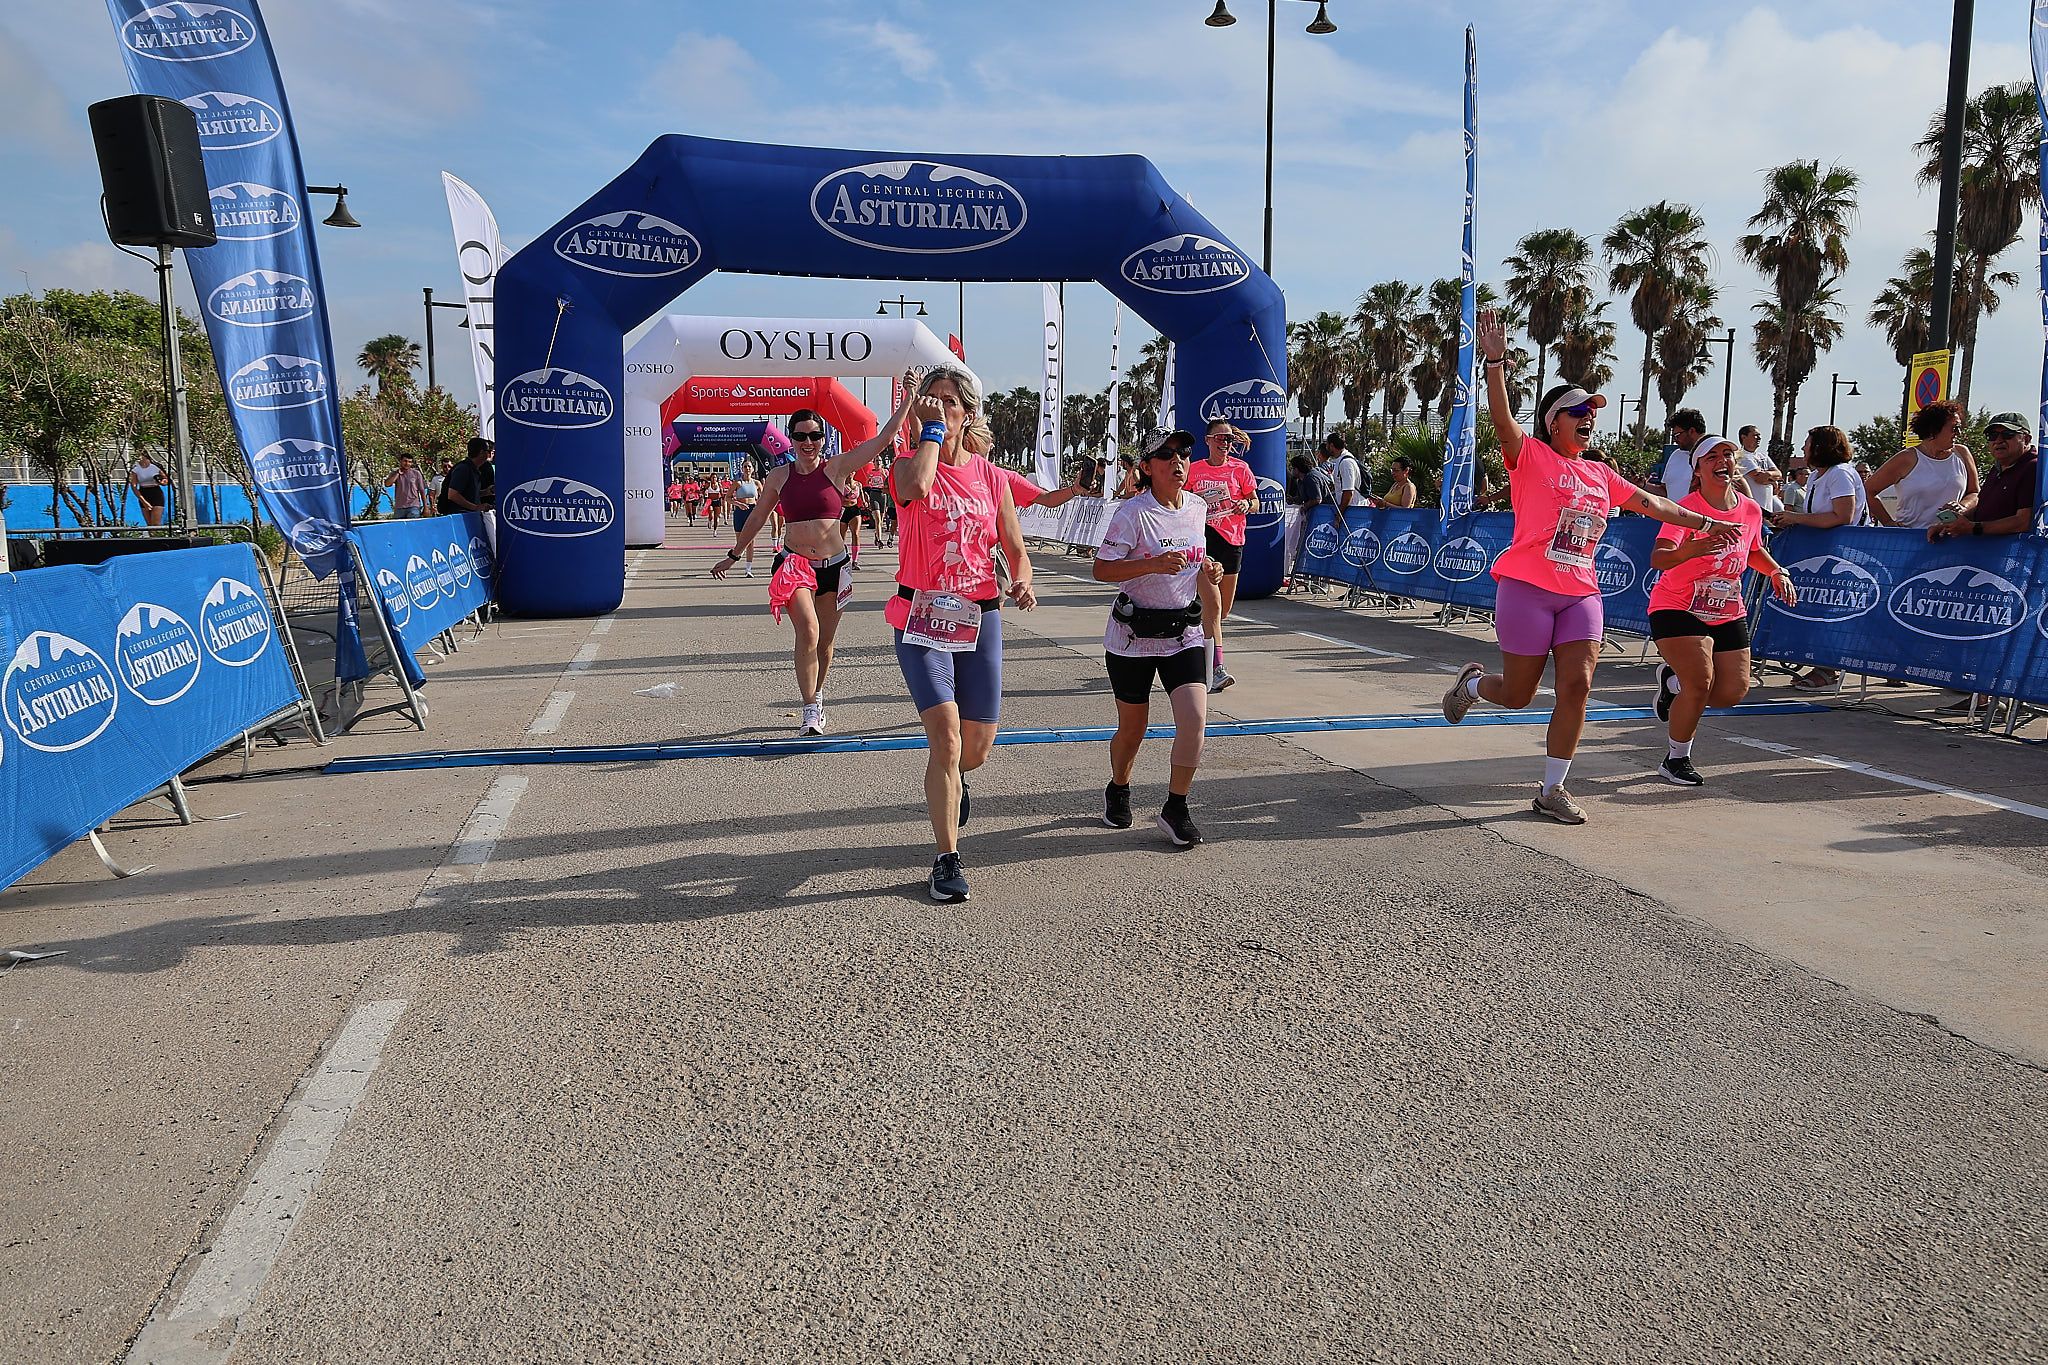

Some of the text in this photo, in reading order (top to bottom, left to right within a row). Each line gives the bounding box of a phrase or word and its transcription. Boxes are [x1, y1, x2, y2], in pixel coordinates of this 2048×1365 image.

[862, 184, 1004, 200] CENTRAL LECHERA
[828, 185, 1011, 231] ASTURIANA
[589, 230, 689, 246] CENTRAL LECHERA
[563, 232, 690, 264] ASTURIANA
[1152, 254, 1196, 263] CENTRAL
[1132, 258, 1244, 281] ASTURIANA
[719, 328, 873, 362] OYSHO
[626, 363, 674, 375] OYSHO
[521, 387, 605, 399] CENTRAL LECHERA
[690, 385, 811, 400] Sports Santander
[506, 389, 608, 417] ASTURIANA
[625, 426, 652, 437] SHO
[566, 498, 605, 506] LECHERA
[625, 489, 654, 499] SHO
[508, 498, 608, 523] ASTURIANA
[1571, 536, 1587, 547] 016
[1386, 546, 1426, 565] ASTURIANA
[1436, 551, 1481, 571] ASTURIANA
[1708, 598, 1725, 607] 016
[1921, 587, 2014, 603] CENTRAL LECHERA
[214, 608, 236, 622] CENTRAL
[1896, 588, 2013, 626] ASTURIANA
[207, 611, 268, 652] ASTURIANA
[930, 618, 957, 632] 016
[129, 627, 186, 654] CENTRAL LECHERA
[124, 640, 198, 688] ASTURIANA
[24, 671, 61, 693] CENTRAL
[17, 674, 114, 736] ASTURIANA
